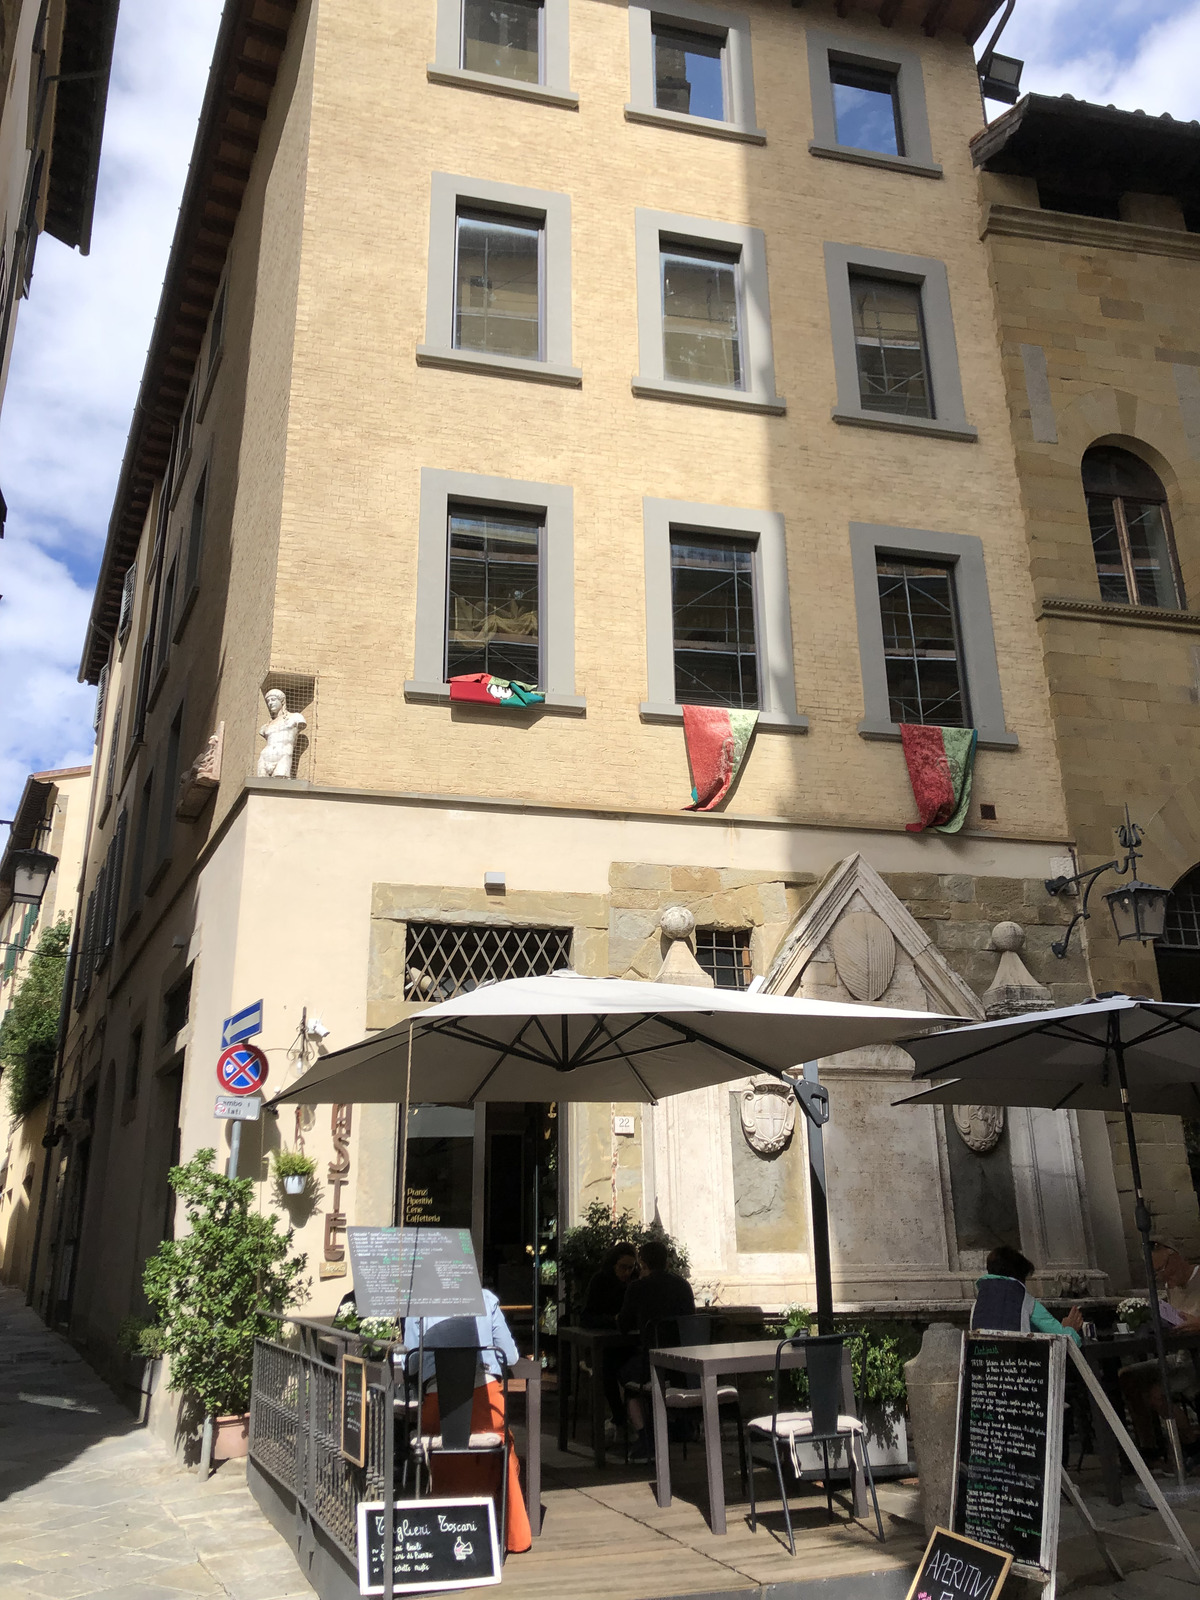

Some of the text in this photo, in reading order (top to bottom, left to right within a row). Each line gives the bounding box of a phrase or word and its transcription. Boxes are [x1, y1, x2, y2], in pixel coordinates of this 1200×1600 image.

[618, 1117, 630, 1128] 22
[407, 1187, 429, 1196] Pranzi
[406, 1196, 433, 1206] Aperitivi
[406, 1206, 423, 1214] Cene
[405, 1214, 441, 1223] Caffetteria
[437, 1514, 478, 1533] Toscani
